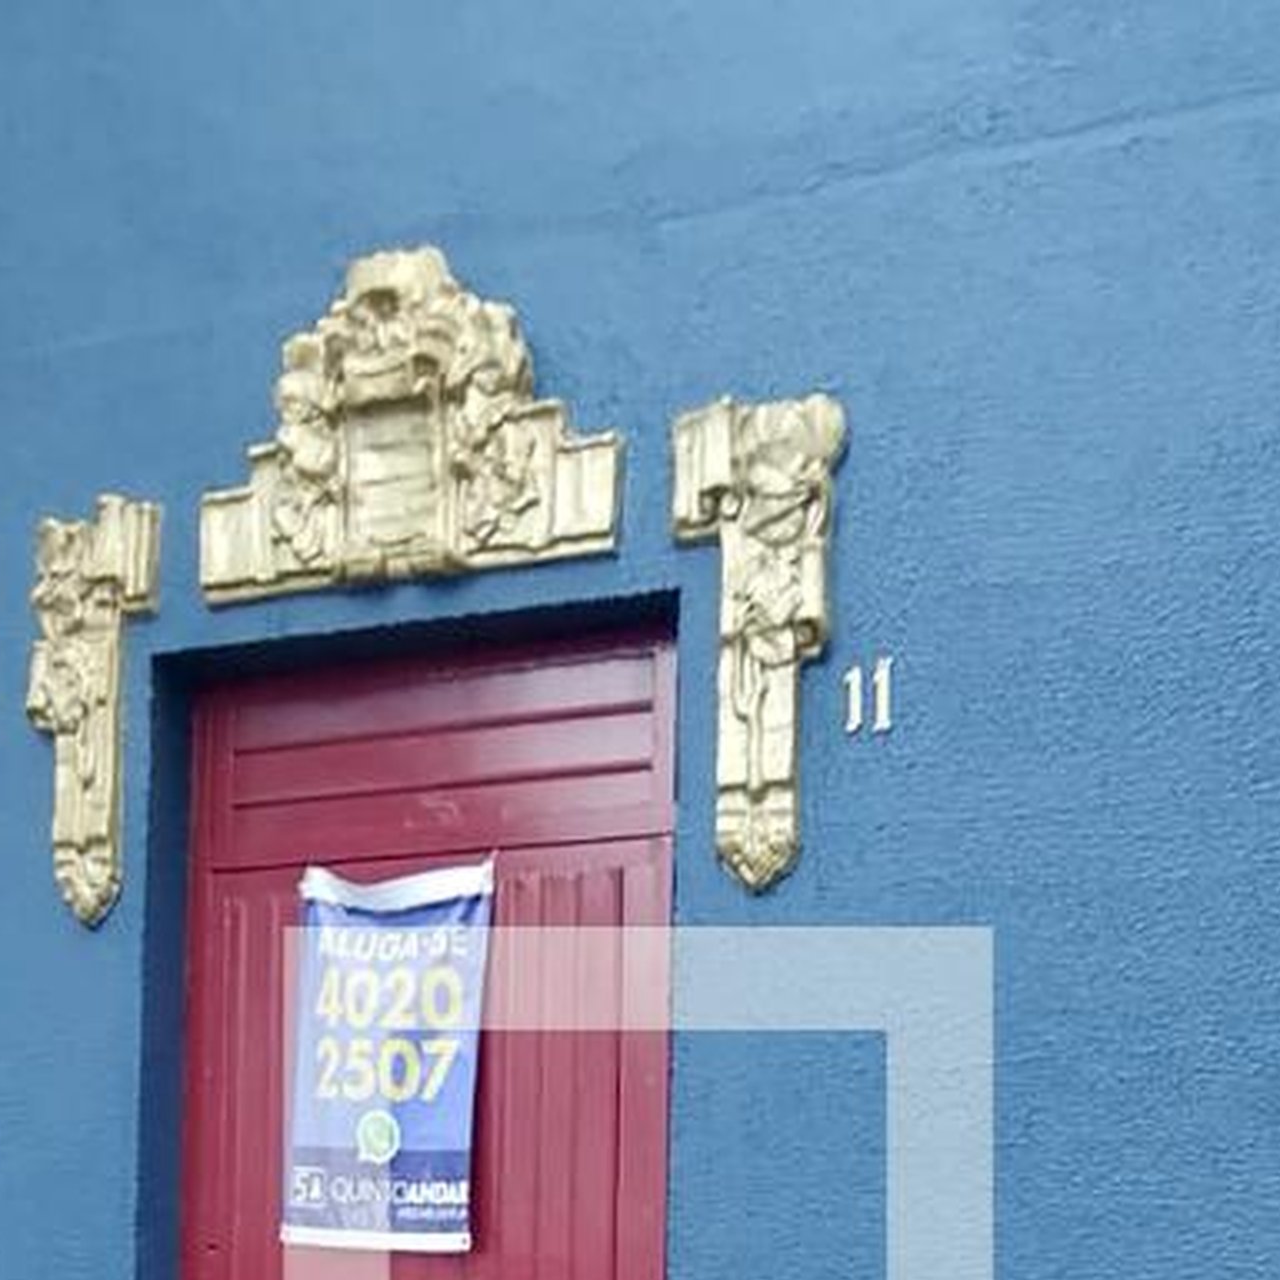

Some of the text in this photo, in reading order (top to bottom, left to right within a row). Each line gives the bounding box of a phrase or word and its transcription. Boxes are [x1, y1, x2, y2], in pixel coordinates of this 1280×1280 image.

[842, 655, 894, 733] 11
[315, 964, 464, 1032] 4020
[316, 1035, 462, 1104] 2507
